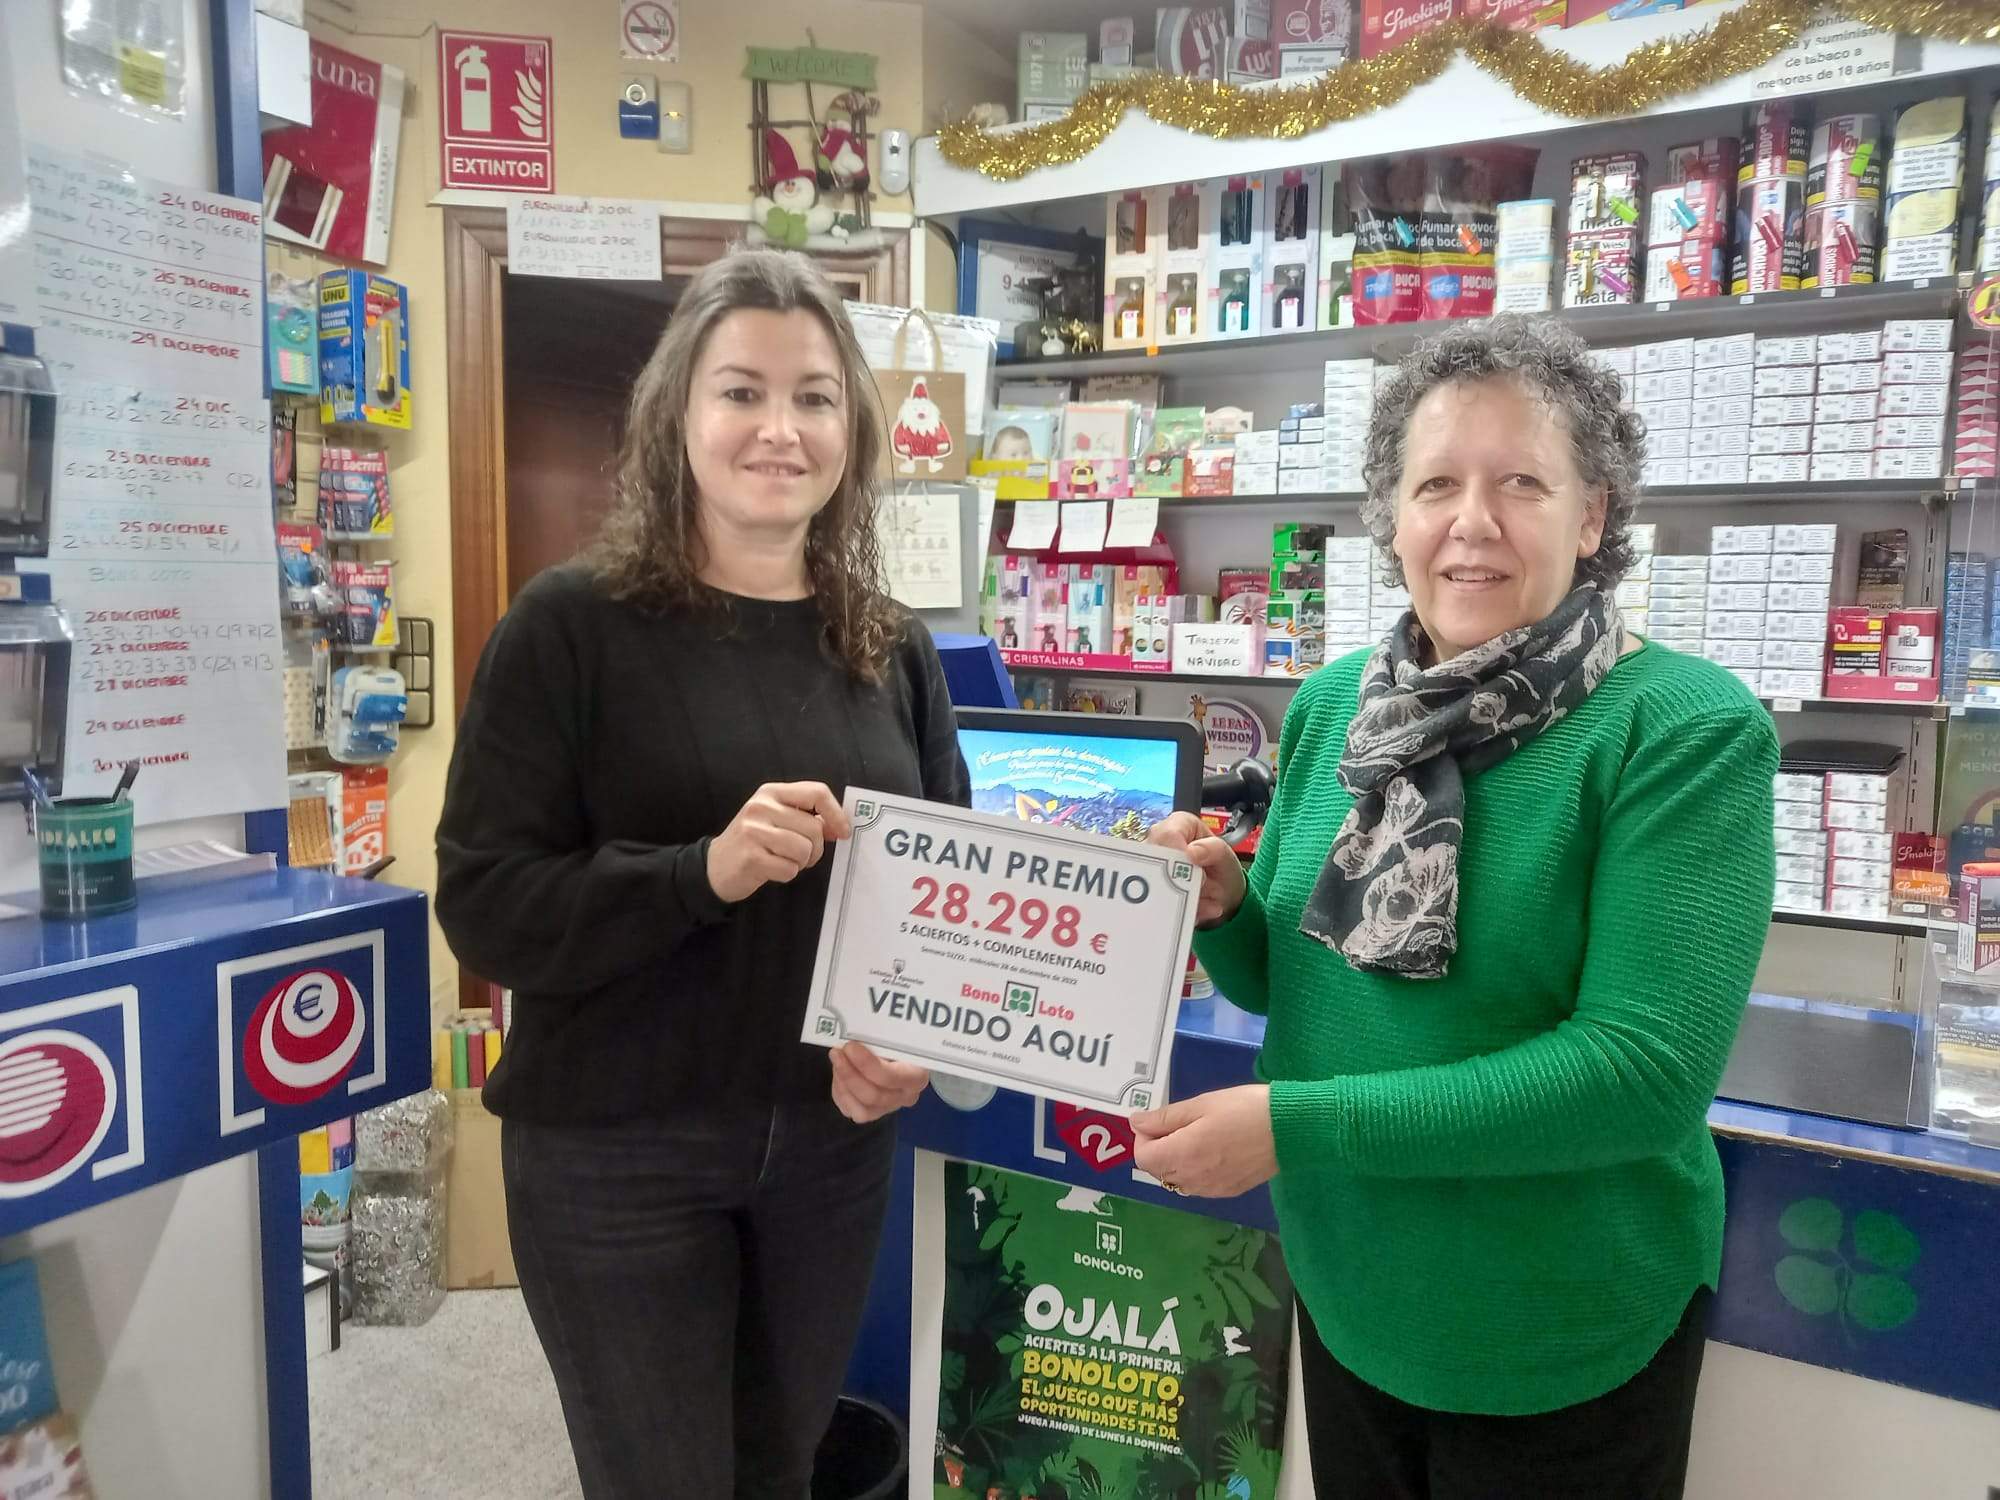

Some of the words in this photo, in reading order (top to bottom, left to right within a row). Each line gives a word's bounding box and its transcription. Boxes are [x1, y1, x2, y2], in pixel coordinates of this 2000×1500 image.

[1382, 0, 1452, 39] Smoking
[1802, 40, 1812, 50] y
[1785, 57, 1801, 68] de
[1804, 49, 1851, 66] tabaco
[1854, 47, 1862, 57] a
[1756, 72, 1814, 89] menores
[1816, 68, 1834, 80] de
[1838, 65, 1853, 76] 18
[1856, 59, 1890, 75] años
[451, 156, 545, 179] EXTINTOR
[159, 192, 186, 210] 24
[191, 199, 260, 226] DICIEMBRE
[1421, 219, 1456, 234] Fumar
[1436, 235, 1464, 248] boca
[131, 331, 158, 348] 29
[161, 337, 240, 360] DICIEMBRE
[175, 397, 201, 411] 24
[133, 453, 212, 468] DICIEMBRE
[119, 520, 143, 534] 25
[147, 522, 230, 535] DICIEMBRE
[84, 610, 107, 625] 26
[110, 607, 181, 623] DICIEMBRE
[90, 643, 114, 656] 27
[120, 640, 191, 654] DICIEMBRE
[1013, 654, 1085, 667] CRISTALINAS
[1186, 657, 1241, 668] NAVIDAD
[1889, 662, 1928, 674] Fumar
[122, 675, 189, 690] DICIEMBRE
[84, 718, 107, 735] 29
[112, 714, 187, 732] DICIEMBRE
[1206, 730, 1254, 743] WISDOM
[884, 827, 993, 875] GRAN
[1004, 850, 1150, 905] PREMIO
[1896, 846, 1947, 864] Smoking
[1895, 881, 1946, 898] Smoking
[909, 875, 1082, 948] 28.298
[1090, 932, 1109, 955] €
[899, 922, 907, 933] 5
[909, 924, 970, 947] ACIERTOS
[983, 939, 1106, 976] COMPLEMENTARIO
[960, 983, 1001, 1005] Bono
[1038, 1000, 1075, 1022] Loto
[868, 986, 1012, 1043] VENDIDO
[1021, 1023, 1114, 1067] AQUÍ
[1073, 1251, 1144, 1281] BONOLOTO
[1023, 1283, 1182, 1356] OJALÁ
[1023, 1333, 1087, 1357] ACIERTES
[1088, 1345, 1099, 1359] A
[1100, 1347, 1117, 1364] LA
[1118, 1350, 1185, 1375] PRIMERA.
[1022, 1349, 1186, 1408] BONOLOTO,
[1021, 1377, 1041, 1397] EL
[1043, 1382, 1101, 1408] JUEGO
[1101, 1393, 1140, 1415] QUE
[1140, 1401, 1179, 1424] MÁS
[1019, 1396, 1137, 1433] OPORTUNIDADES
[1137, 1419, 1157, 1436] TE
[1158, 1423, 1181, 1442] DA.
[1017, 1413, 1049, 1429] JUEGA
[1048, 1419, 1081, 1436] AHORA
[1081, 1425, 1094, 1438] DE
[1094, 1427, 1127, 1445] LUNES
[1125, 1435, 1134, 1446] A
[1133, 1436, 1185, 1457] DOMINGO.
